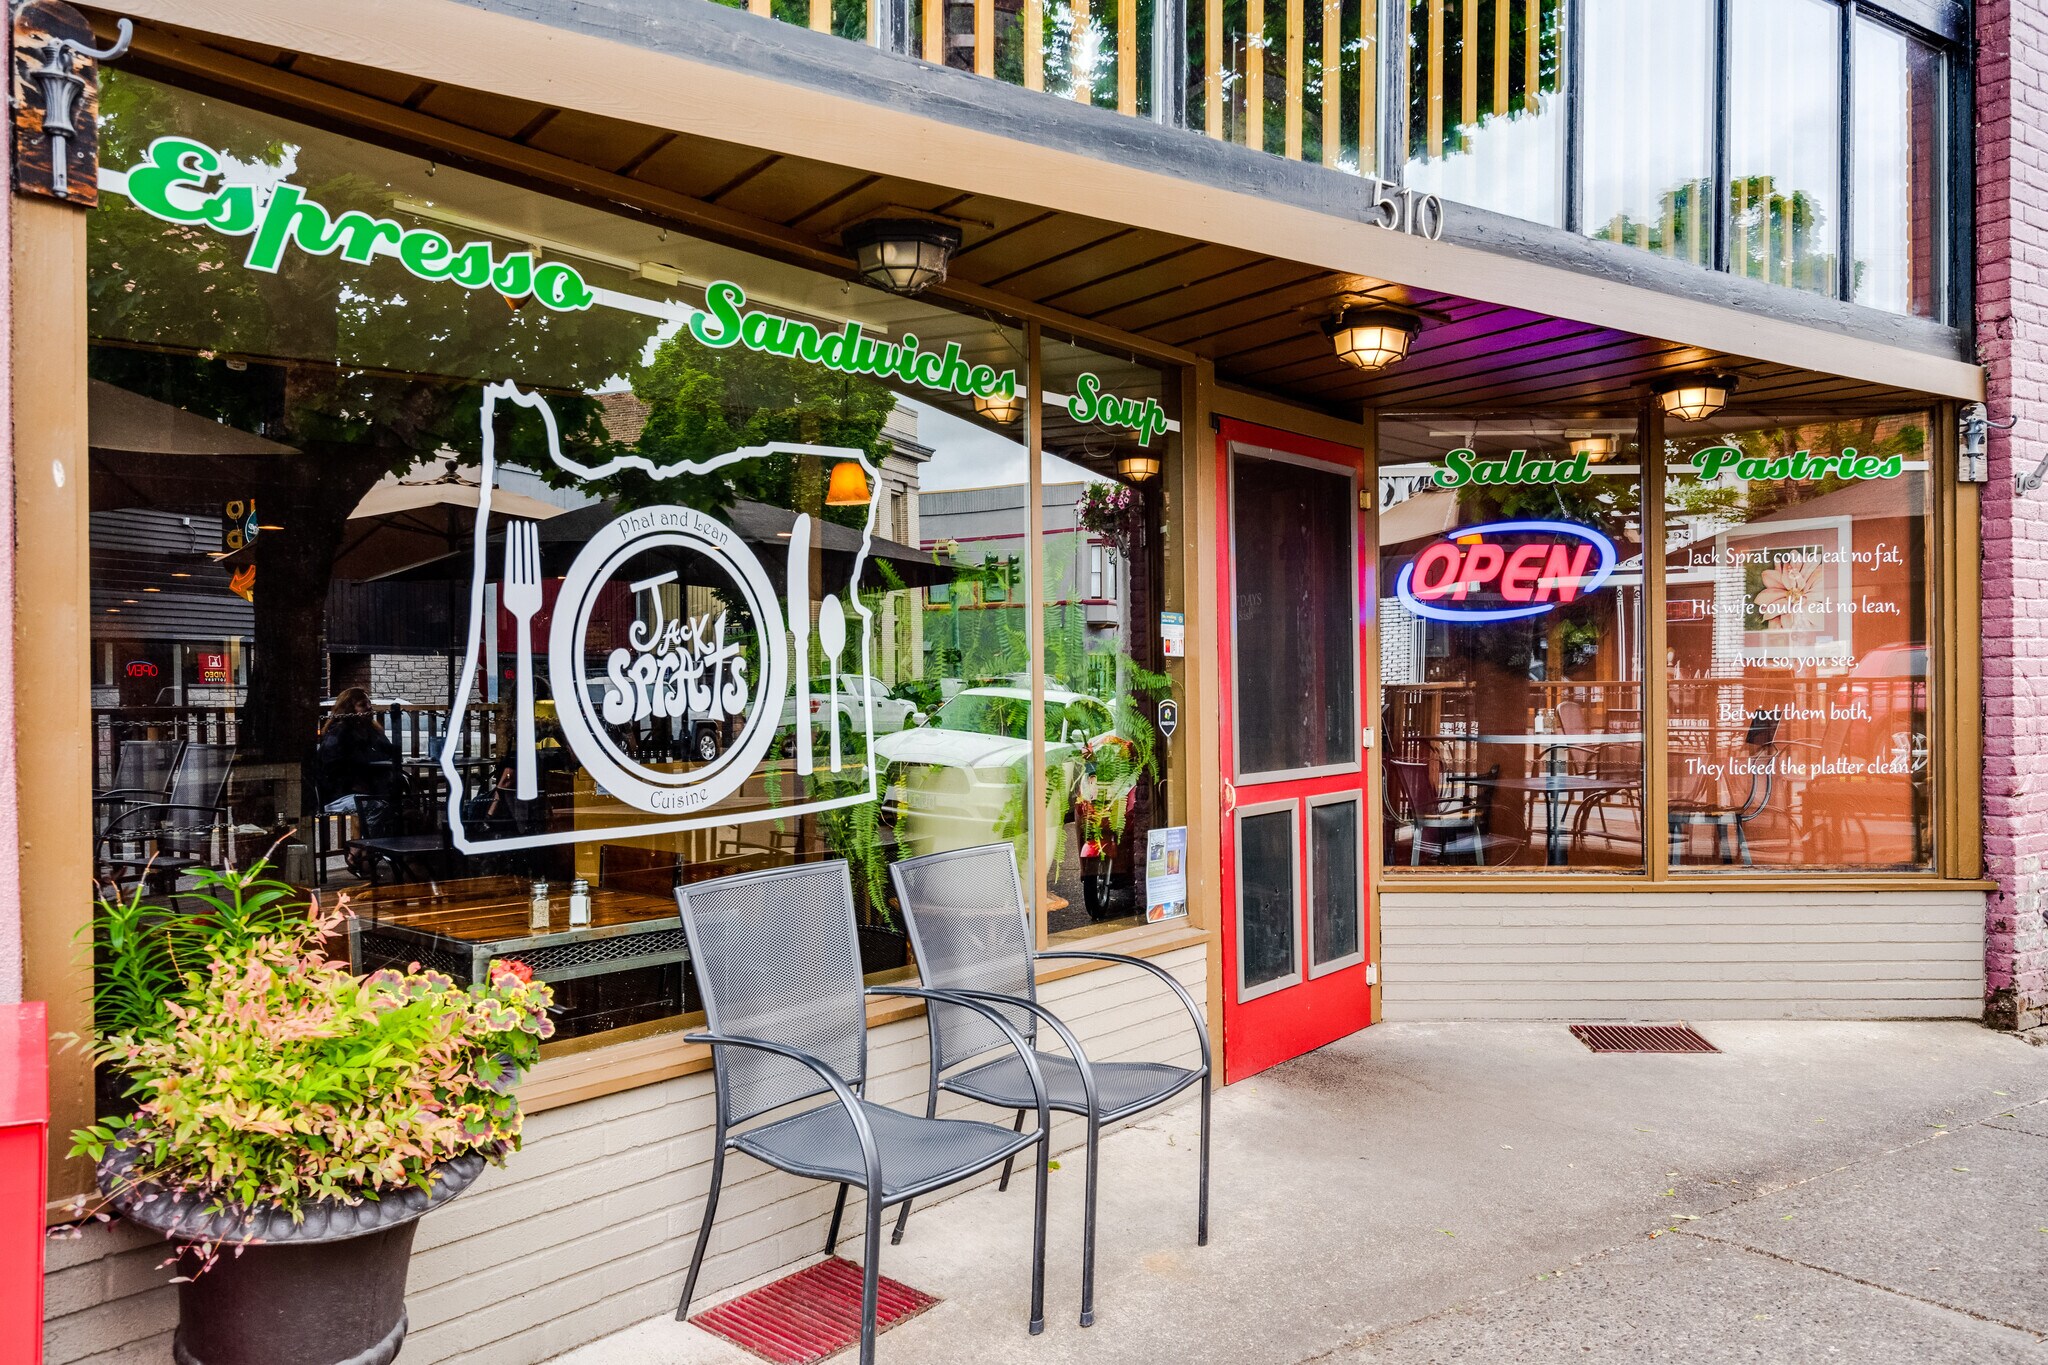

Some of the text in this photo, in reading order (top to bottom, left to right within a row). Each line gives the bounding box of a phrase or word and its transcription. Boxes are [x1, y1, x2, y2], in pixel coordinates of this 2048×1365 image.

[127, 136, 593, 312] Espresso
[1371, 179, 1443, 241] 510
[688, 280, 1016, 402] Sandwiches
[1068, 373, 1168, 447] Soup
[1433, 448, 1593, 488] Salad
[1691, 447, 1904, 481] Pastries
[660, 511, 689, 527] and
[693, 514, 729, 546] Lean
[1410, 543, 1593, 604] OPEN
[1687, 543, 1903, 571] Jack Sprat could eat no fat,
[1692, 598, 1718, 615] His
[1722, 594, 1754, 621] wife
[1758, 595, 1803, 614] could
[1808, 599, 1833, 614] eat
[1837, 601, 1858, 614] no
[1862, 594, 1900, 616] lean,
[1732, 650, 1859, 672] And so, you see,
[1719, 702, 1872, 723] Betwixt them both,
[1685, 756, 1914, 781] They licked the platter clean.
[650, 789, 709, 809] Cuisine
